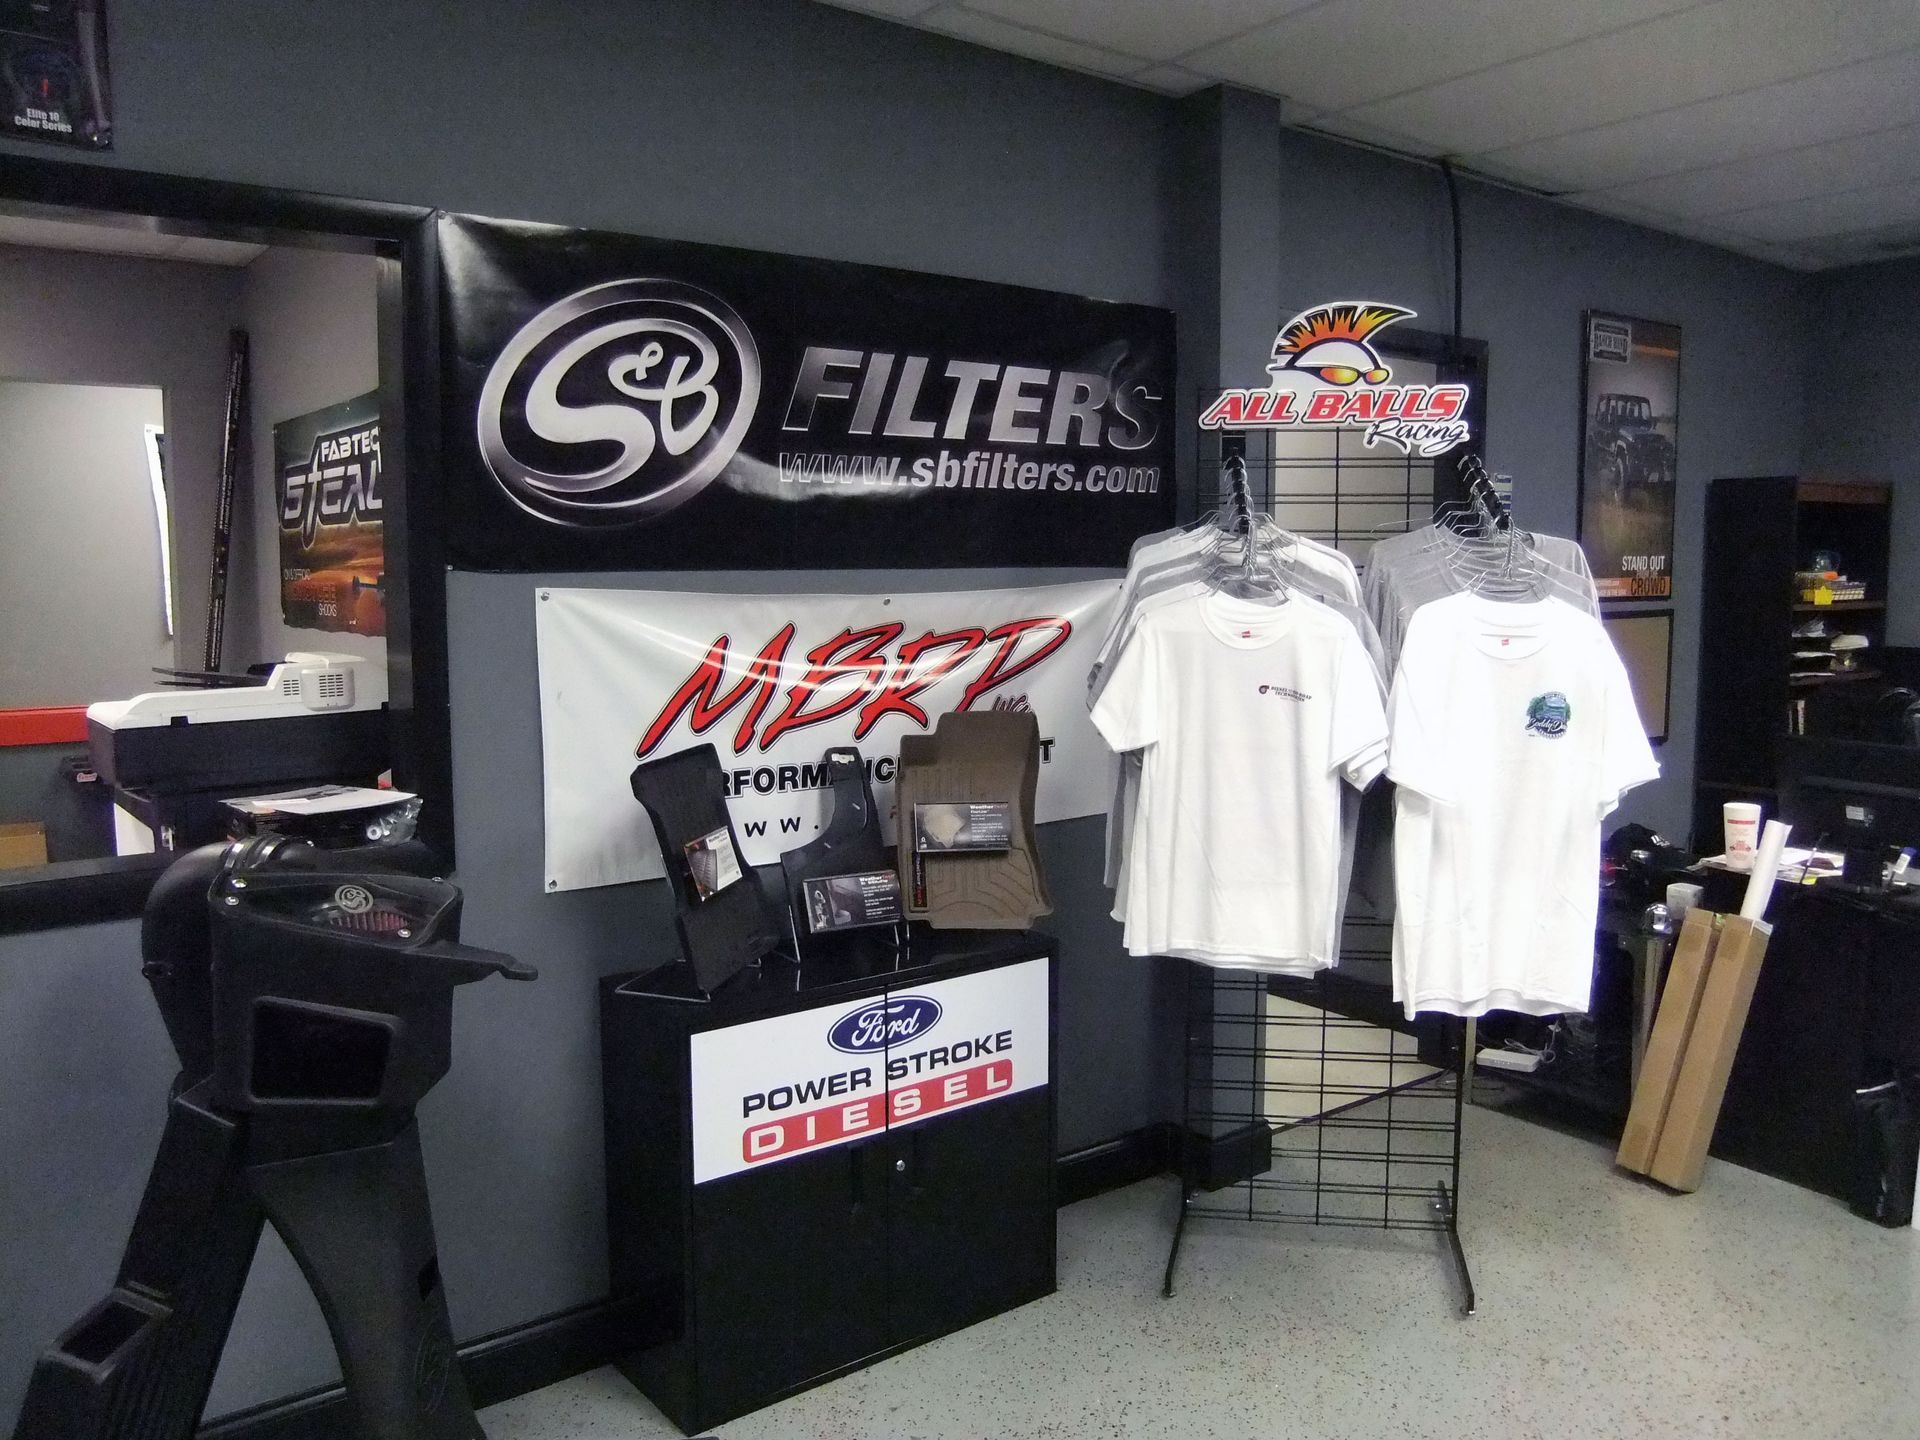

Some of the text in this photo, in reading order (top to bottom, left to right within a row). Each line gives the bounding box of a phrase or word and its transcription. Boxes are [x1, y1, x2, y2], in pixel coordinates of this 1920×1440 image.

[14, 115, 73, 133] Color Series
[525, 317, 720, 492] S&B
[781, 346, 1163, 450] FILTERS
[1203, 386, 1466, 425] ALL BALLS
[1366, 416, 1467, 454] Racing
[778, 449, 1161, 494] www.sbfilters.com
[1622, 555, 1665, 571] STAND OUT
[1630, 577, 1666, 596] CROWD
[635, 616, 1074, 759] MBRP
[851, 1004, 920, 1047] Ford
[743, 1030, 1012, 1118] POWER STROKE
[750, 1067, 1008, 1156] DIESEL
